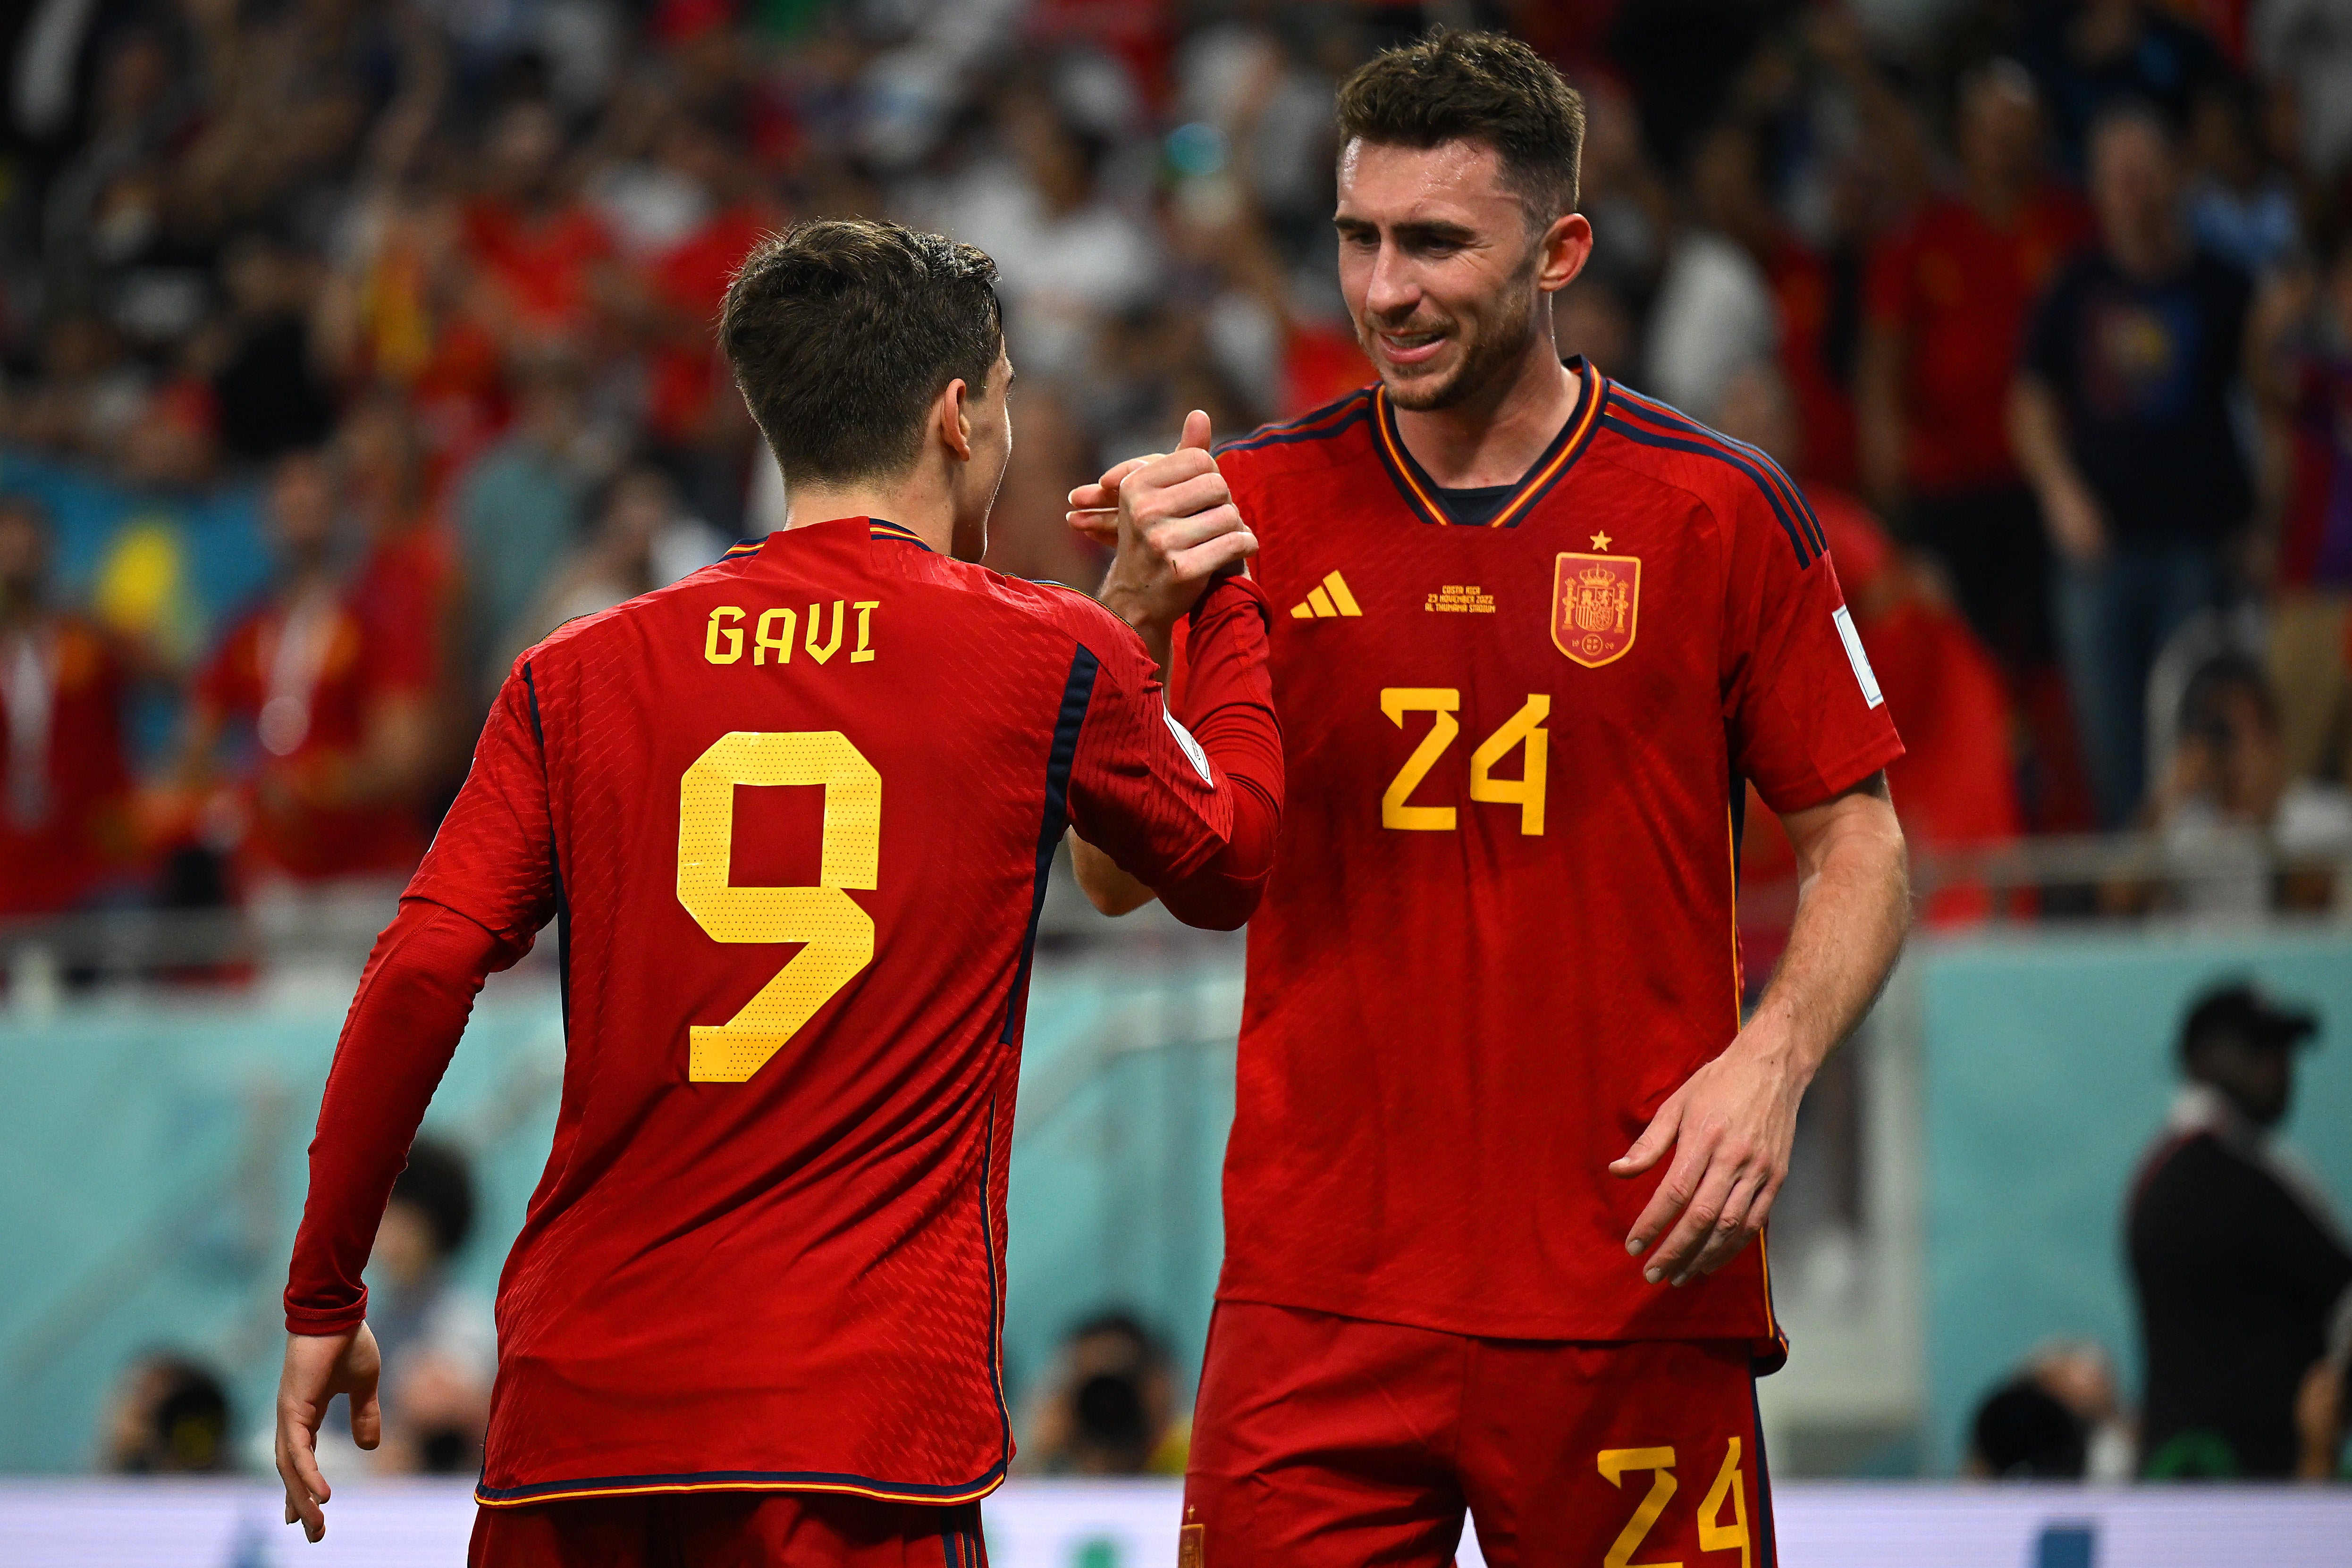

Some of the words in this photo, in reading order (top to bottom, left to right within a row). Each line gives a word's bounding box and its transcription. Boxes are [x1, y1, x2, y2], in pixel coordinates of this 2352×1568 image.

[1425, 602, 1434, 612] AL
[1435, 603, 1468, 613] THUMAMA
[1468, 604, 1496, 613] STADIUM
[1428, 593, 1438, 603] 23
[1439, 595, 1475, 604] NOVEMBER
[1476, 595, 1494, 604] 2022
[1442, 585, 1464, 595] COSTA
[1466, 586, 1481, 595] RICA
[704, 600, 880, 665] GAVI
[1380, 688, 1551, 836] 24
[676, 731, 882, 1082] 9
[1597, 1436, 1751, 1568] 24
